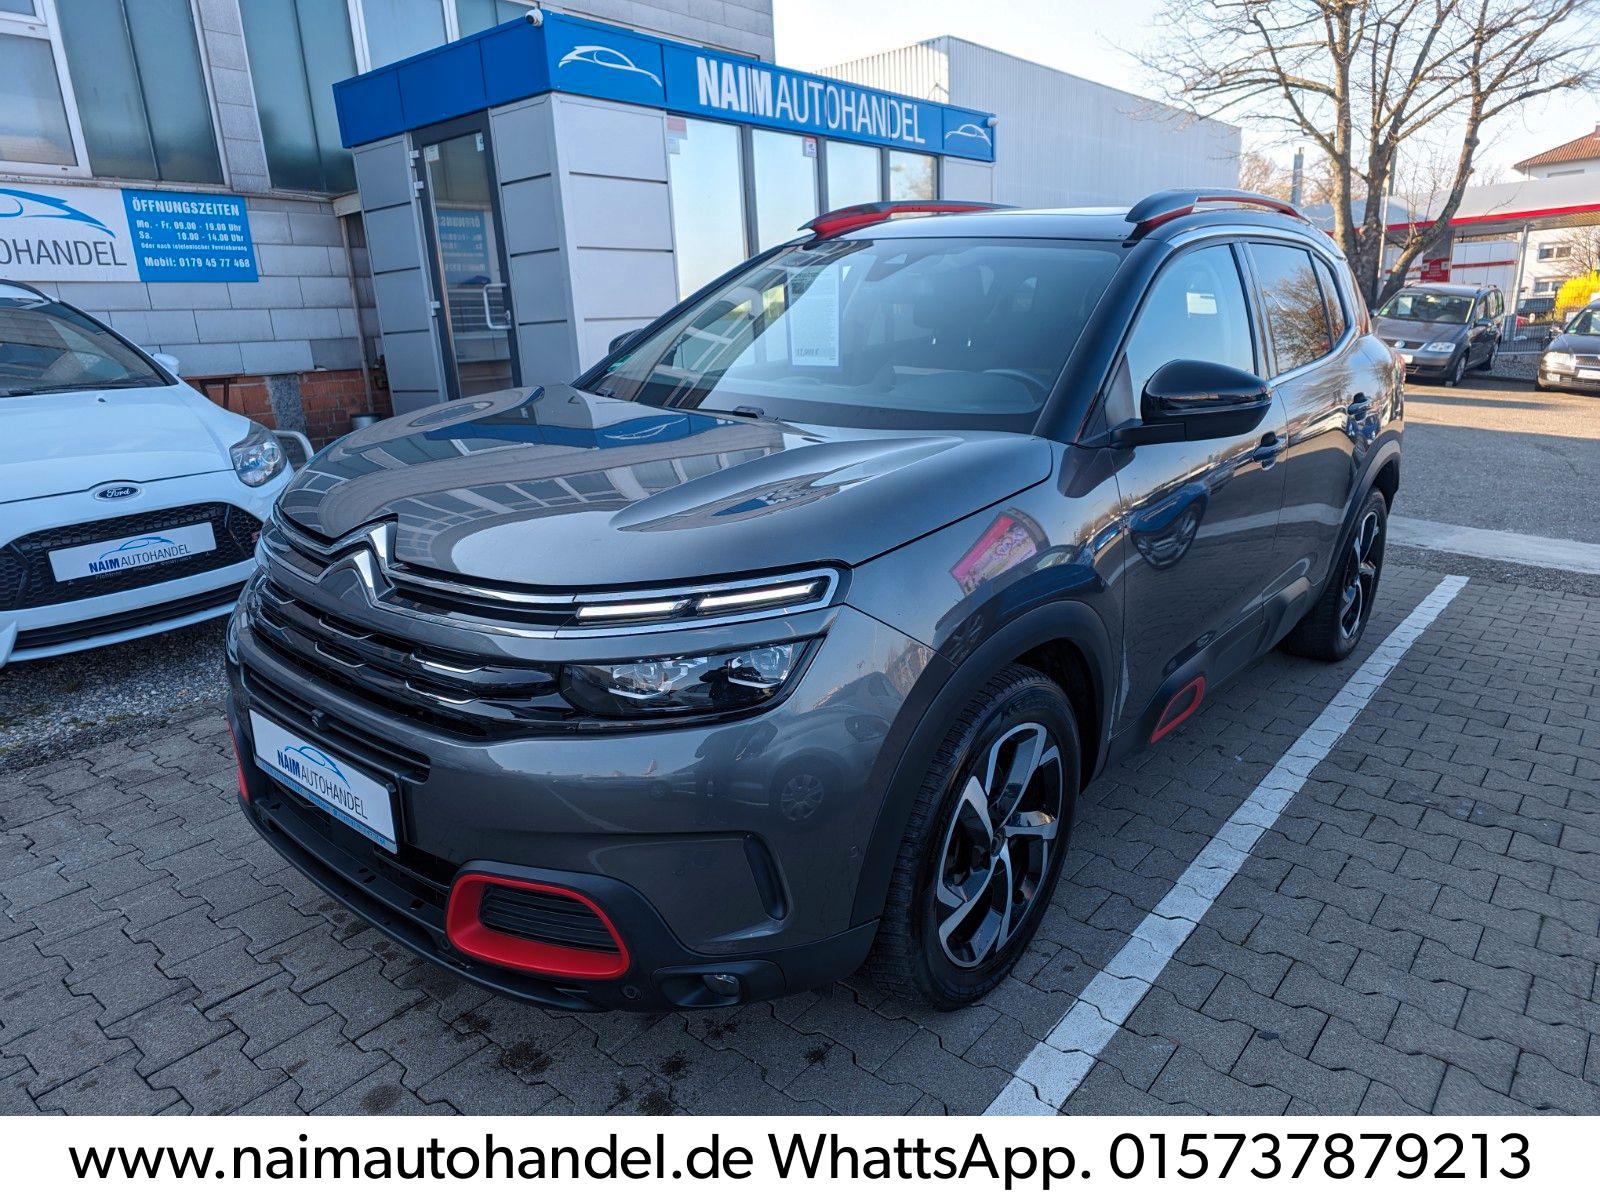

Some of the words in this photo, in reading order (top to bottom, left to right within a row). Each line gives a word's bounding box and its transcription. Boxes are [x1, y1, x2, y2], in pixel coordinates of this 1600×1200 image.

[131, 196, 240, 216] ÖFFNUNGSZEITEN
[136, 219, 153, 229] Mo.
[160, 220, 172, 230] Fr.
[228, 223, 242, 232] Uhr
[138, 230, 153, 239] Sa.
[230, 233, 244, 242] Uhr
[144, 257, 177, 267] Mobil:
[178, 257, 203, 267] 0179
[205, 258, 217, 267] 45
[220, 258, 230, 267] 77
[106, 488, 131, 498] Ford
